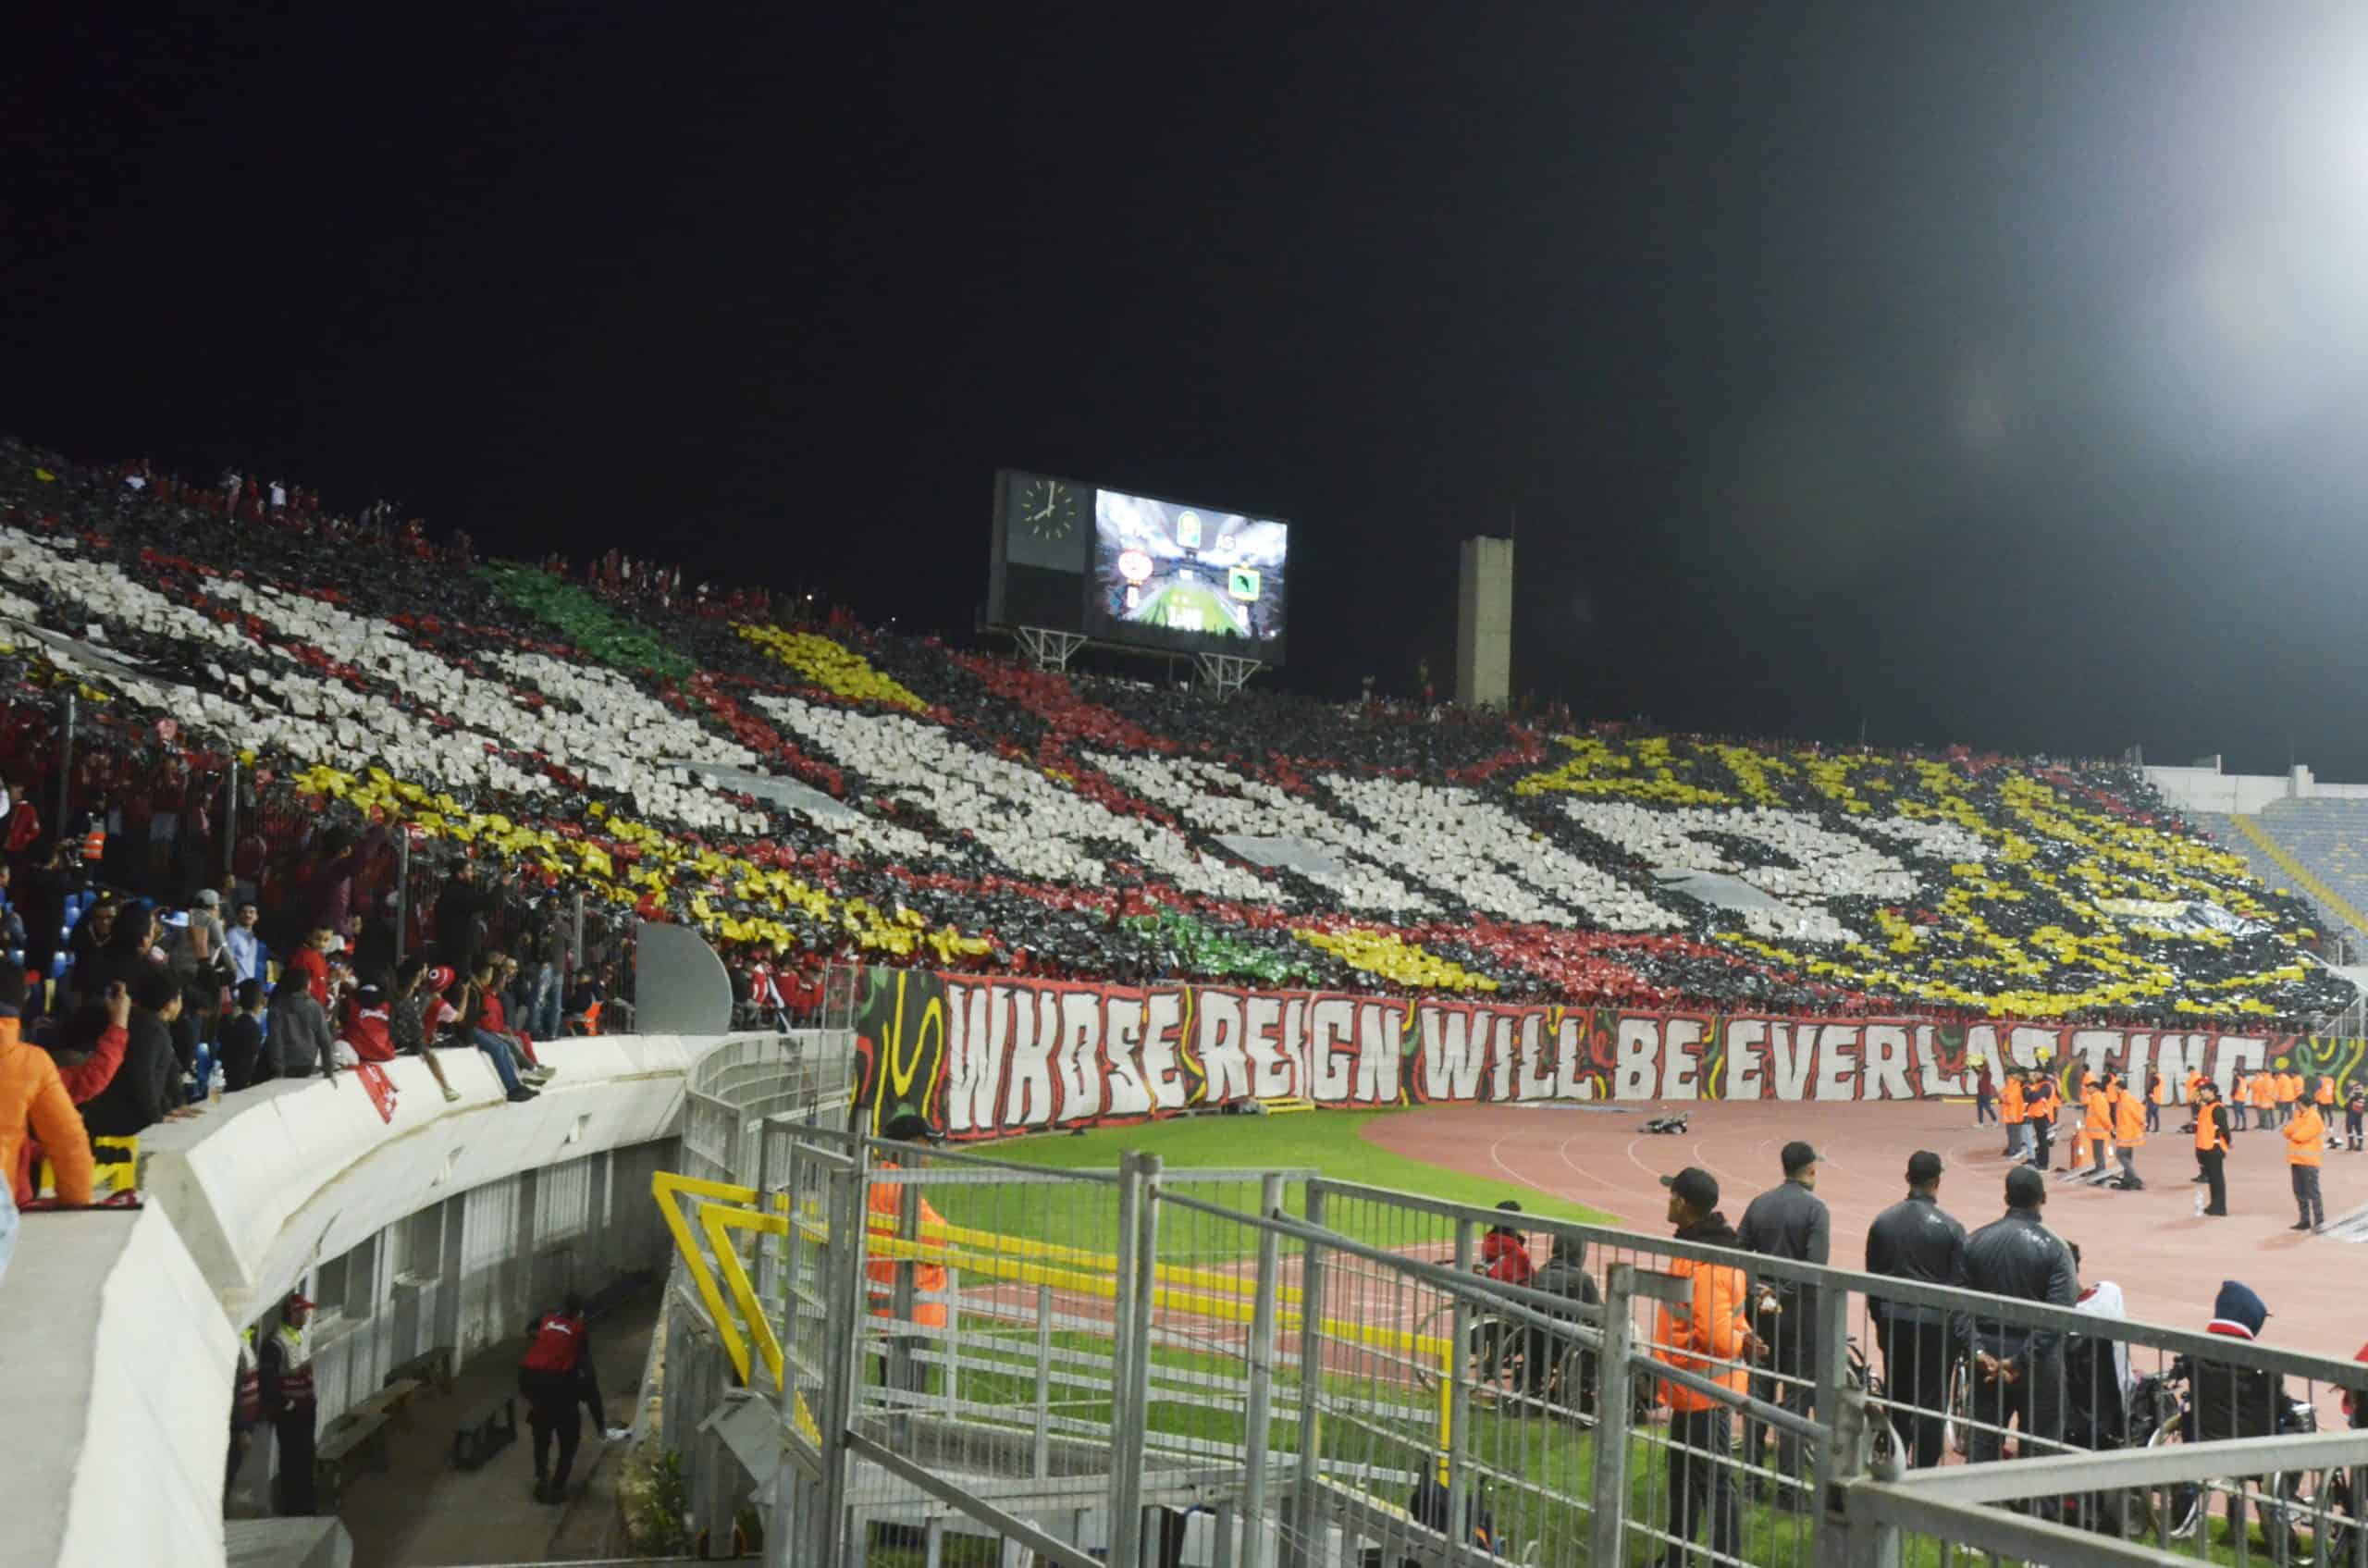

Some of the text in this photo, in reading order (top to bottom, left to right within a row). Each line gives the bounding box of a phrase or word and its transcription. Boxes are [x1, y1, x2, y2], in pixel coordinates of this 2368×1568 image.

[947, 983, 1186, 1130] WHOSE
[1198, 990, 1402, 1103] REIGN
[1420, 1006, 1593, 1101] WILL
[1613, 1019, 1704, 1101] BE
